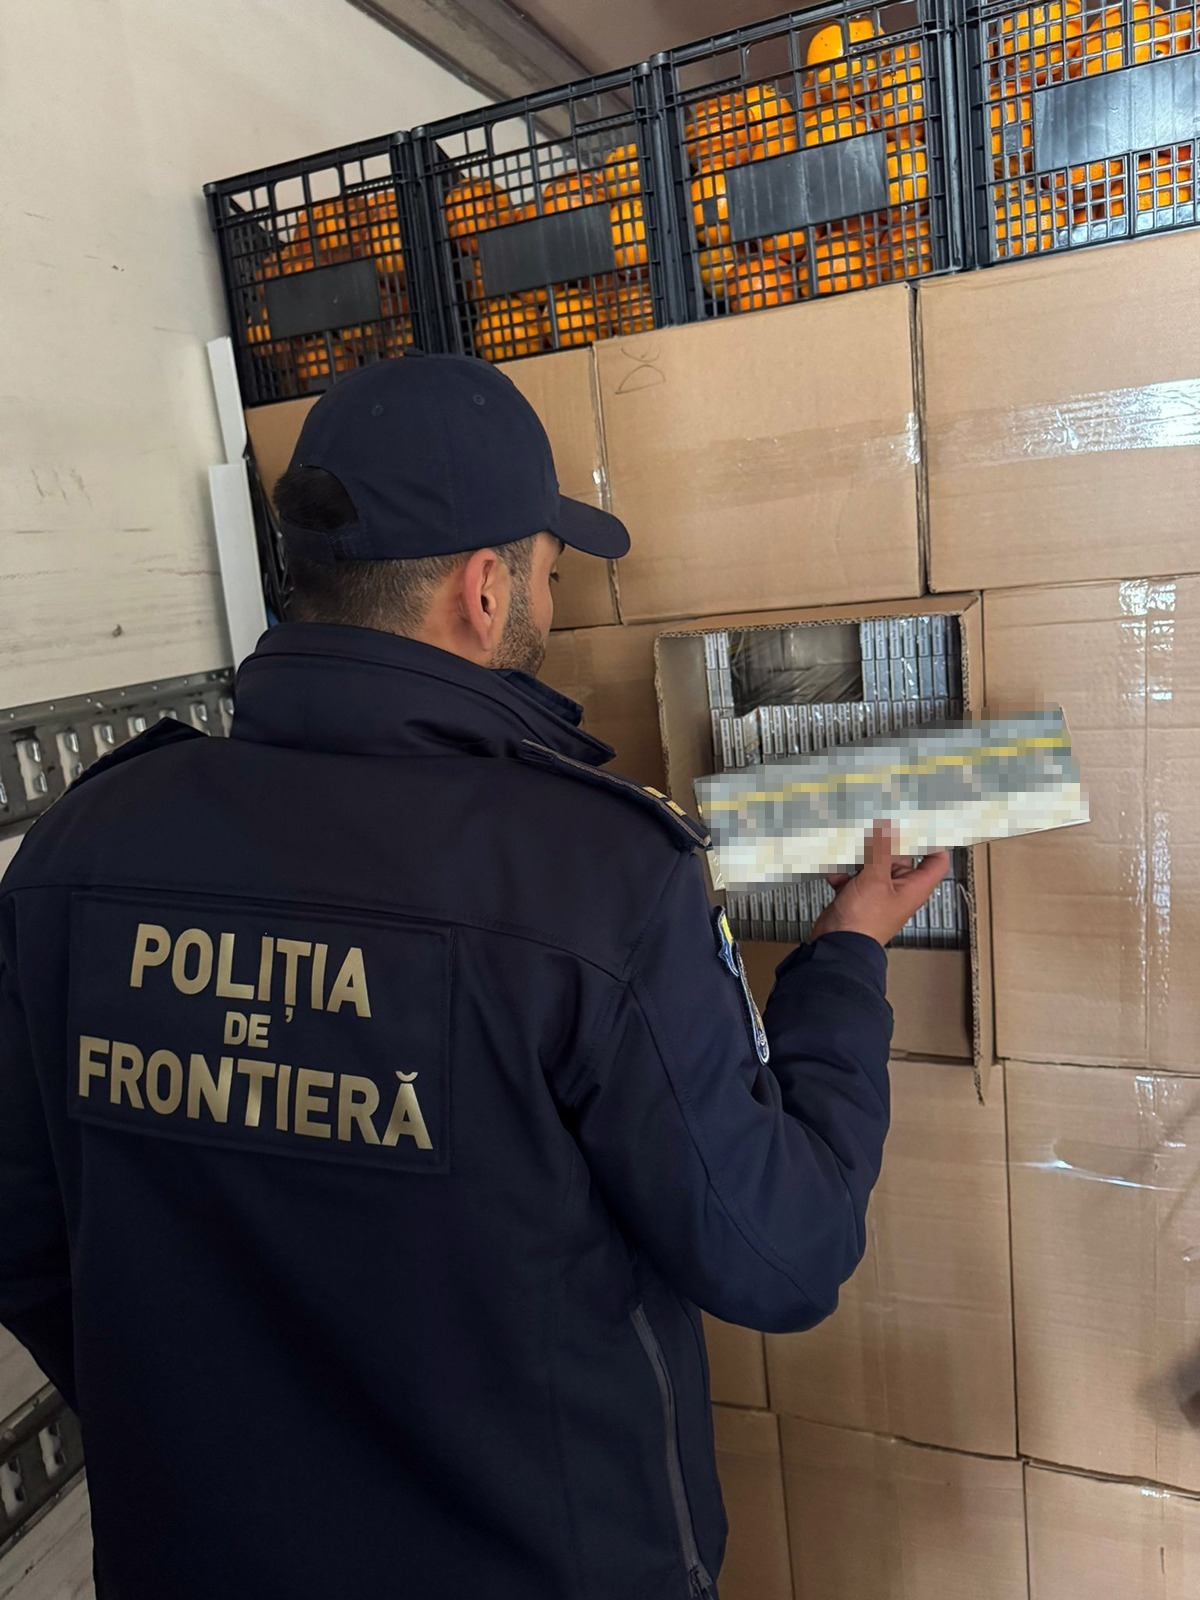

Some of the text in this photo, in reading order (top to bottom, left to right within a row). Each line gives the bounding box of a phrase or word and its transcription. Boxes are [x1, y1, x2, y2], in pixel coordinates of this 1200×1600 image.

[129, 922, 373, 1023] POLIȚIA
[223, 1011, 272, 1049] DE
[78, 1035, 434, 1150] FRONTIERĂ
